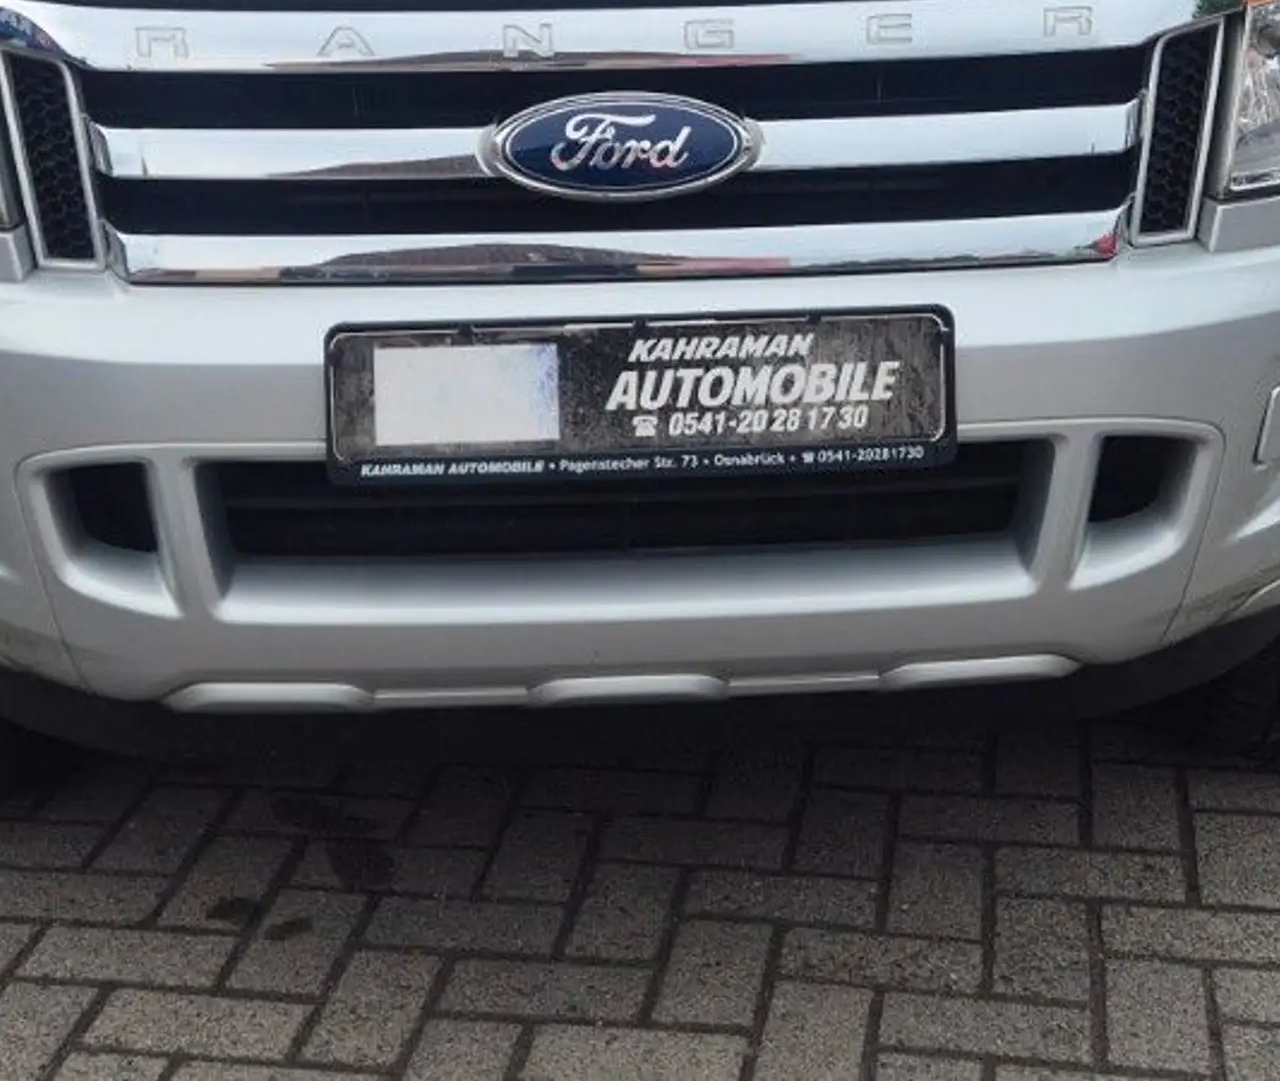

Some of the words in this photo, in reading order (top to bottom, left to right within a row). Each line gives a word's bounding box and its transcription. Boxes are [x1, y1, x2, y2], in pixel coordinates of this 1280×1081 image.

[134, 5, 1094, 59] RANGER
[550, 114, 692, 171] Ford
[627, 333, 815, 362] KAHRAMAN
[605, 361, 900, 411] AUTOMOBILE
[361, 463, 445, 477] KAHRAMAN
[448, 460, 546, 476] AUTOMOBILE
[681, 454, 699, 468] 73
[714, 451, 786, 467] Osnabrück
